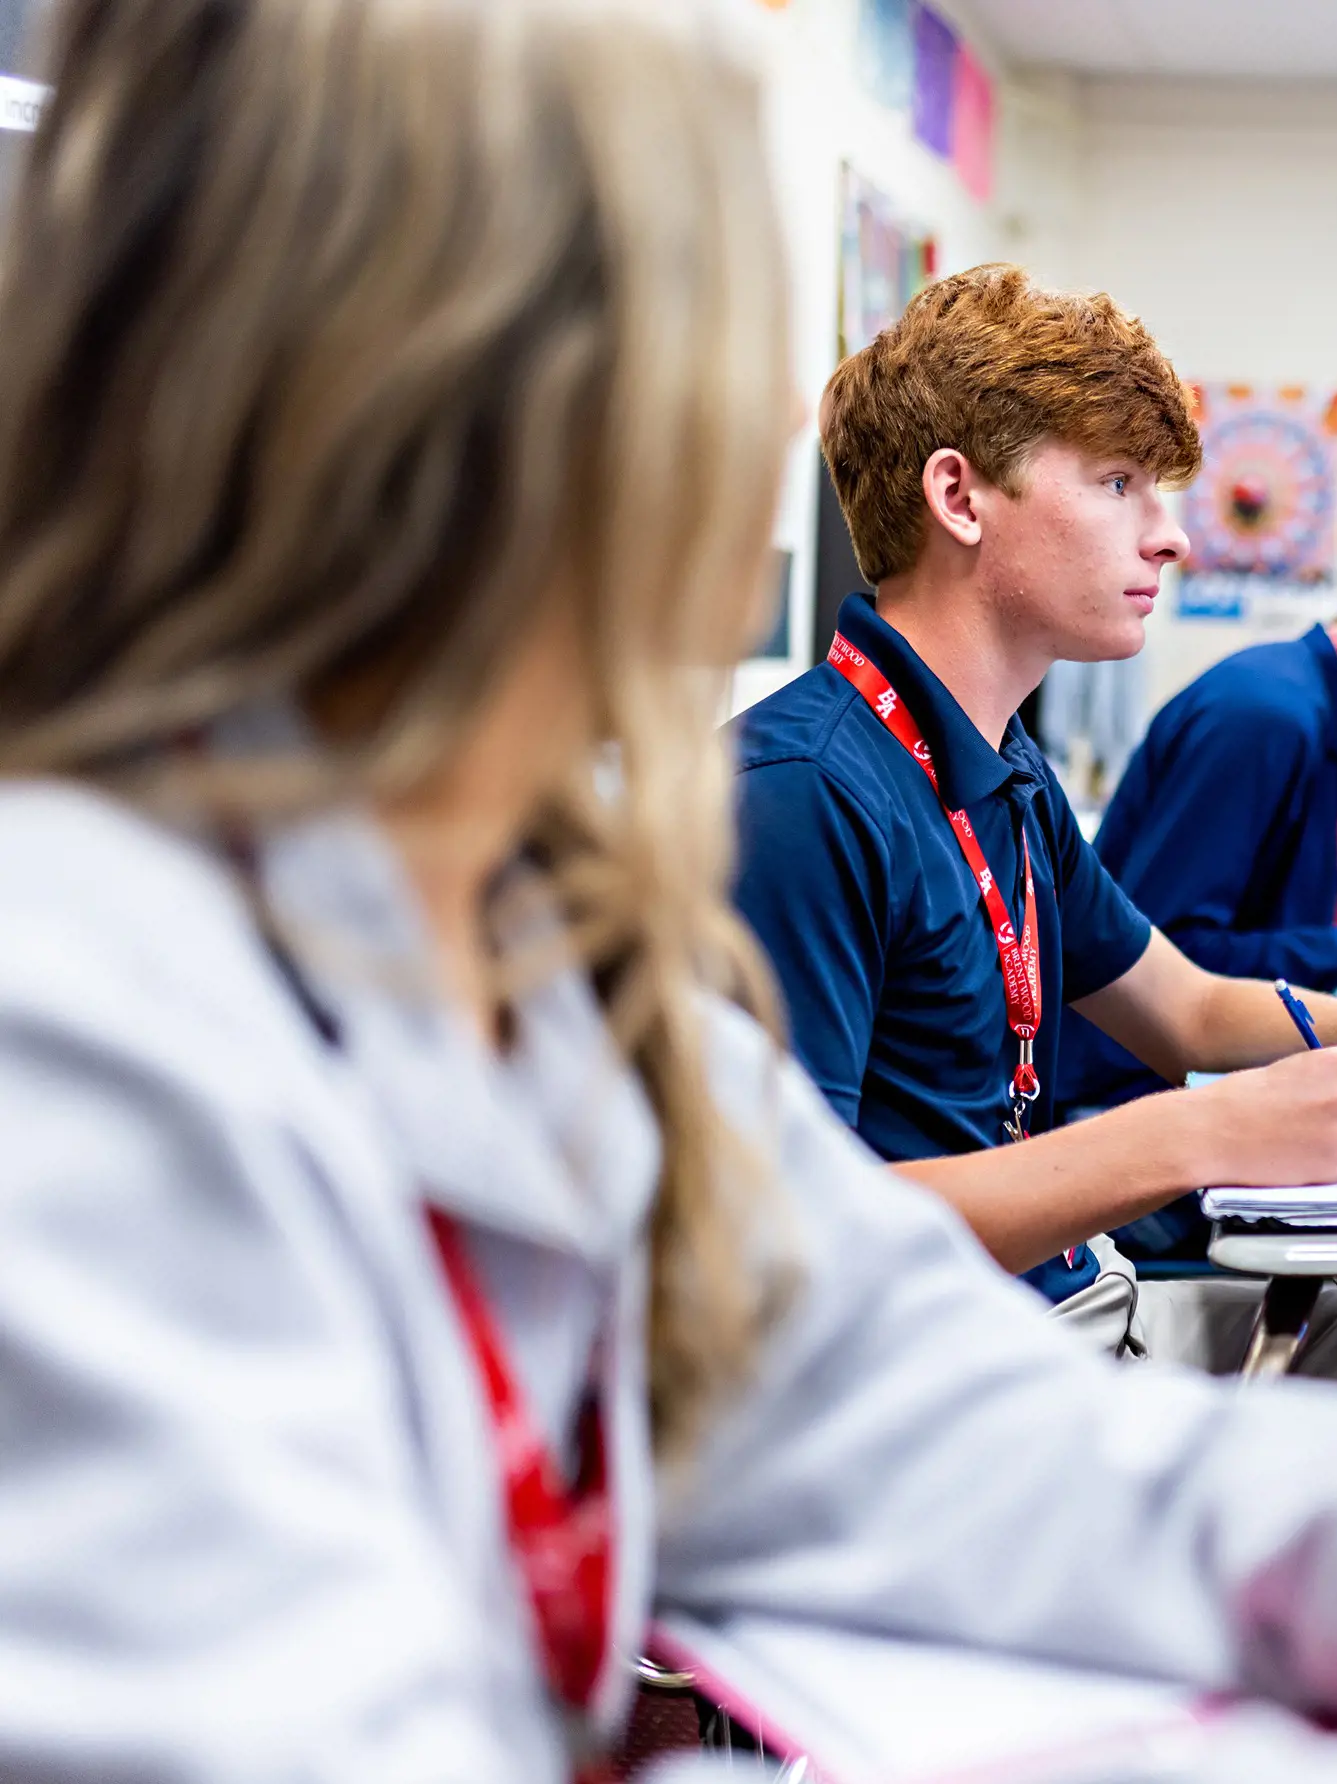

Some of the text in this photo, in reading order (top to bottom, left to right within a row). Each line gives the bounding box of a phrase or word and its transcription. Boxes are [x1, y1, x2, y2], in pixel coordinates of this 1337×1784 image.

[876, 687, 898, 720] BA
[979, 865, 993, 897] BA
[1003, 953, 1020, 1006] ACADEMY
[1011, 947, 1033, 1021] BRENTWOOD
